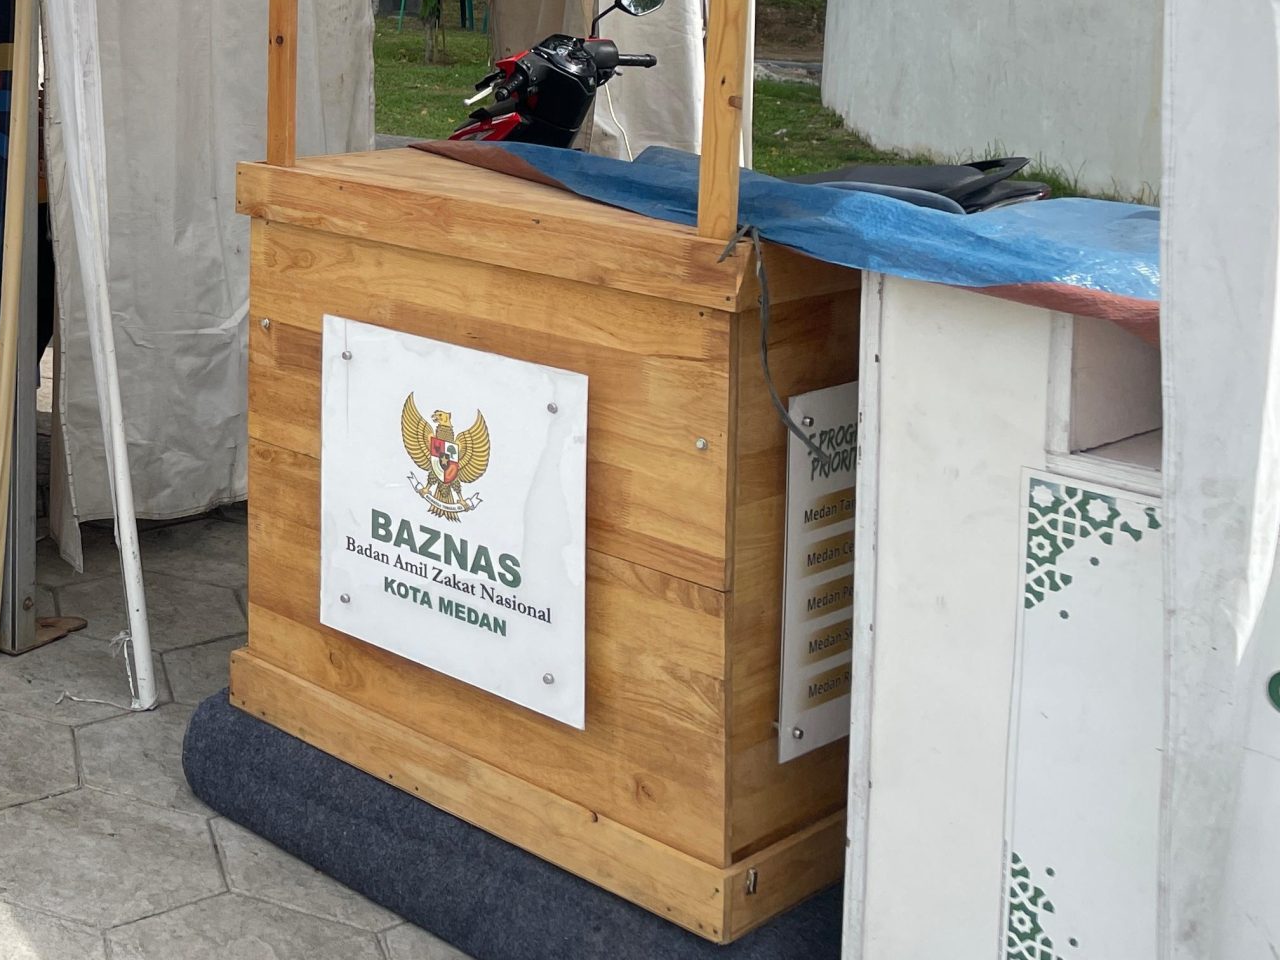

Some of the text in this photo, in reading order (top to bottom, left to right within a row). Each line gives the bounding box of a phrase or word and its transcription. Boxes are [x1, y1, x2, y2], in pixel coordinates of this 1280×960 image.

[804, 503, 838, 524] Medan
[371, 508, 522, 588] BAZNAS
[807, 547, 840, 567] Medan
[345, 535, 552, 624] Badan Amil Zakat Nasional
[384, 576, 507, 637] KOTA MEDAN
[807, 591, 840, 612] Medan
[808, 633, 842, 654] Medan
[808, 676, 841, 698] Medan
